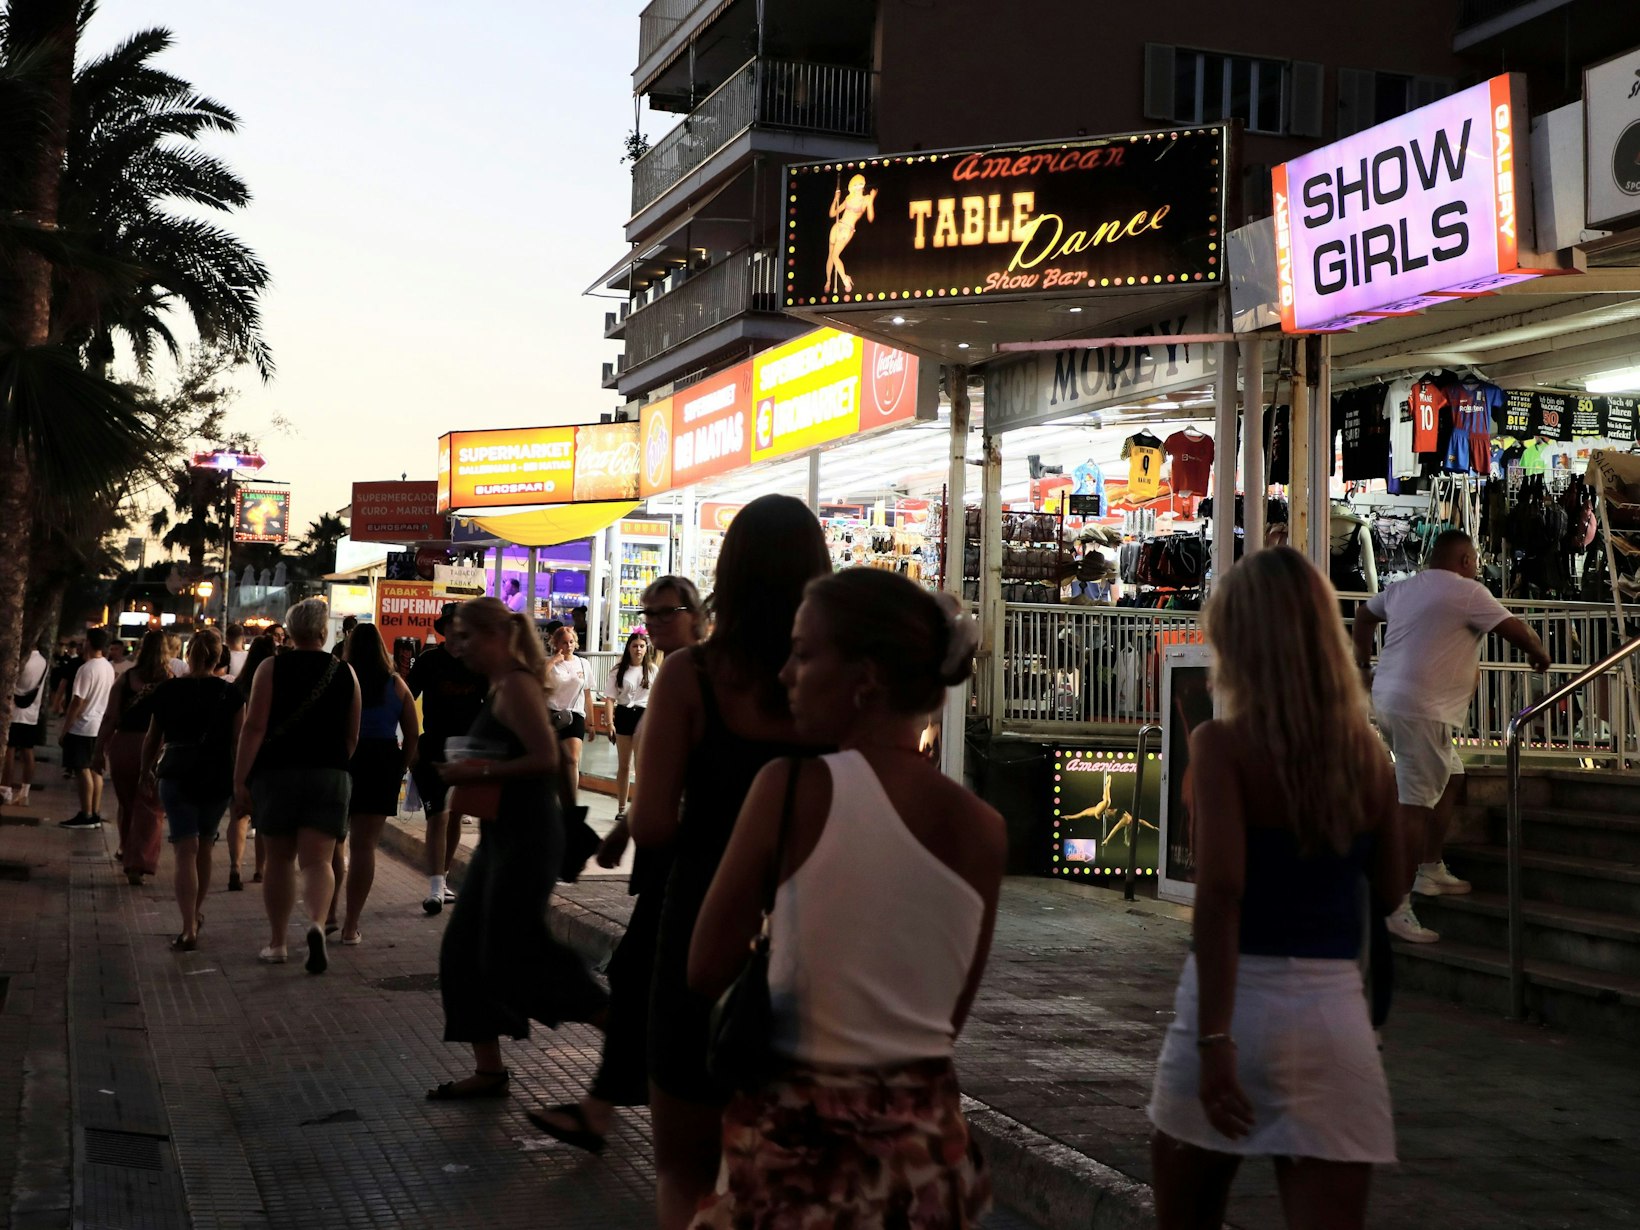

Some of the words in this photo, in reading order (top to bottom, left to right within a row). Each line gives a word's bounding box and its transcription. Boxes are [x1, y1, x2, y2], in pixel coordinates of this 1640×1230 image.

[953, 146, 1125, 182] American
[1303, 118, 1473, 229] SHOW
[1494, 104, 1515, 239] GALERY
[909, 191, 1037, 249] TABLE
[1008, 204, 1171, 272] Dance
[1276, 192, 1293, 306] GALERY
[1313, 200, 1470, 296] GIRLS
[984, 269, 1042, 292] Show
[1044, 268, 1088, 287] Bar
[1050, 316, 1189, 405] MOREY
[989, 361, 1037, 420] SHOP
[1607, 396, 1624, 406] Nach
[1625, 399, 1634, 407] 40
[1420, 405, 1434, 430] 10
[1577, 399, 1593, 412] 50
[1608, 404, 1632, 417] Jahren
[695, 411, 744, 464] MATIAS
[459, 442, 572, 462] SUPERMARKET
[1142, 455, 1150, 476] 9
[1593, 451, 1618, 483] SALES
[356, 493, 438, 503] SUPERMERCADO
[475, 483, 543, 494] EUROSPAR
[384, 587, 418, 596] TABAK
[382, 598, 465, 615] SUPERMA
[381, 615, 403, 626] Bei
